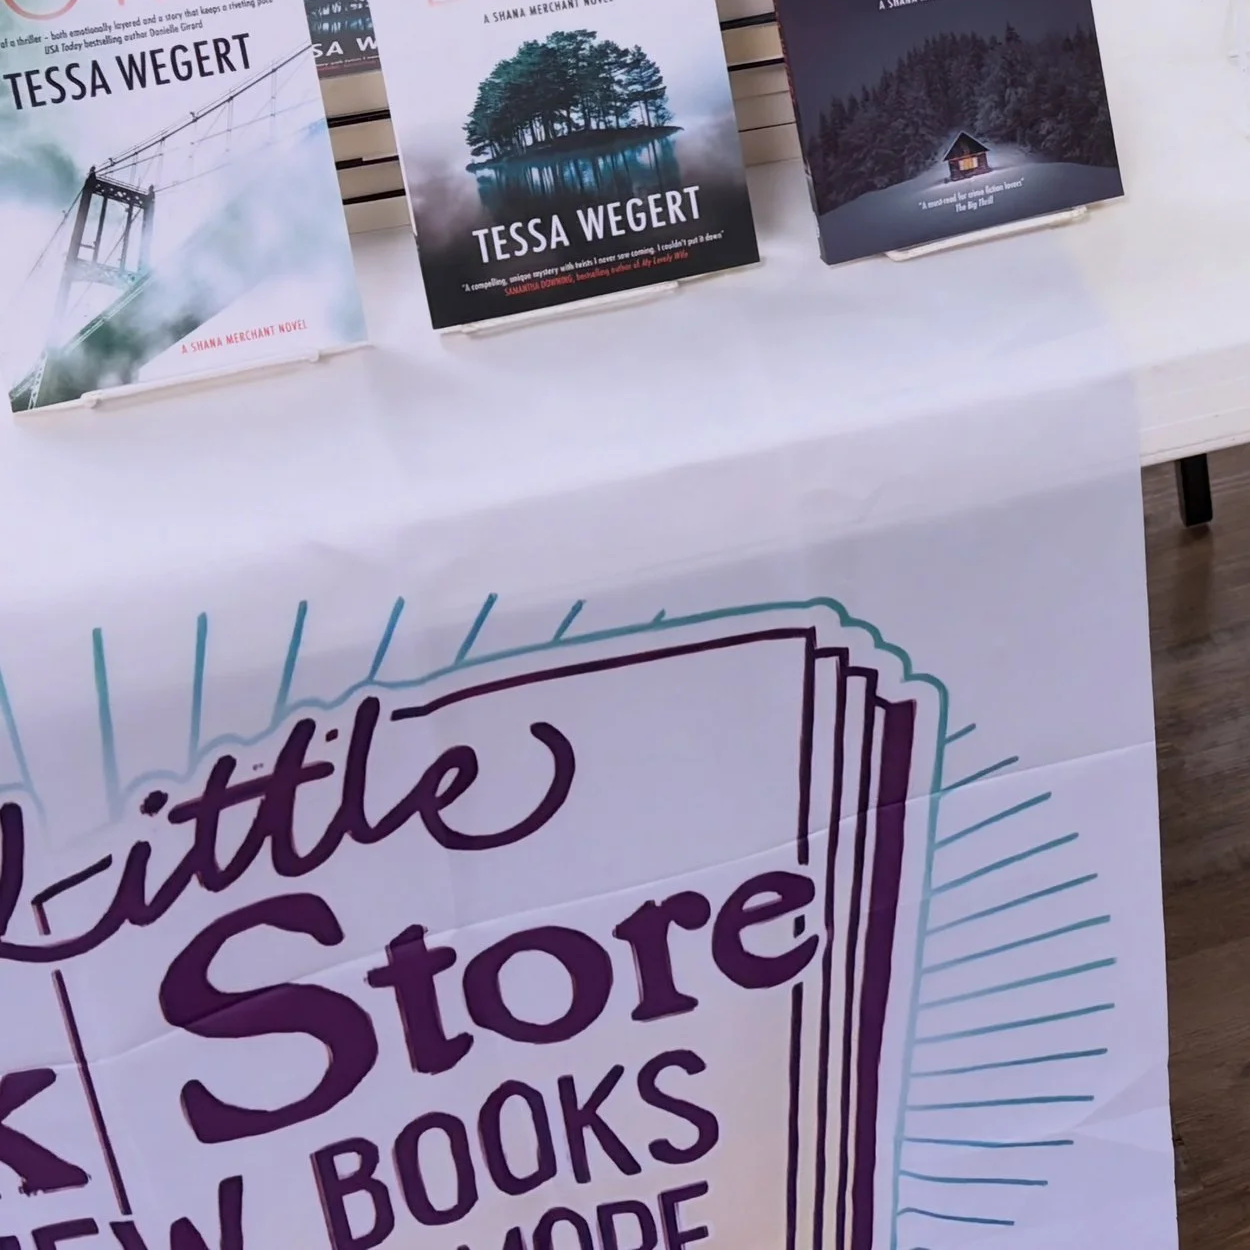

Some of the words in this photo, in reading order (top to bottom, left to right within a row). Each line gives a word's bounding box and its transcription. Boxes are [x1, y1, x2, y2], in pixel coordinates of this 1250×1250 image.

[16, 34, 42, 47] thriller
[50, 30, 68, 40] both
[69, 23, 112, 37] emotionally
[114, 17, 141, 30] layered
[143, 15, 157, 25] and
[165, 12, 183, 23] story
[184, 9, 199, 18] that
[200, 6, 221, 16] keeps
[228, 0, 256, 10] riveting
[483, 13, 491, 24] A
[493, 7, 526, 23] SHANA
[879, 0, 885, 11] A
[44, 44, 59, 55] USA
[61, 41, 83, 52] Today
[84, 35, 123, 48] bestselling
[124, 30, 148, 42] author
[149, 24, 179, 37] Danielle
[180, 20, 203, 32] Girard
[3, 59, 112, 110] TESSA
[115, 33, 250, 91] WEGERT
[472, 214, 570, 264] TESSA
[576, 185, 700, 242] WEGERT
[509, 272, 532, 283] unique
[533, 267, 558, 278] mystery
[560, 261, 574, 271] with
[575, 258, 593, 268] twists
[598, 255, 616, 263] never
[617, 252, 630, 260] saw
[661, 238, 687, 250] couldn't
[687, 237, 698, 246] put
[504, 281, 540, 296] SAMANTHA
[181, 344, 188, 354] A
[190, 337, 223, 352] SHANA
[225, 325, 275, 345] MERCHANT
[278, 319, 308, 333] NOVEL
[0, 696, 575, 963] Little
[158, 868, 821, 1144] Store
[310, 1049, 719, 1250] BOOKS
